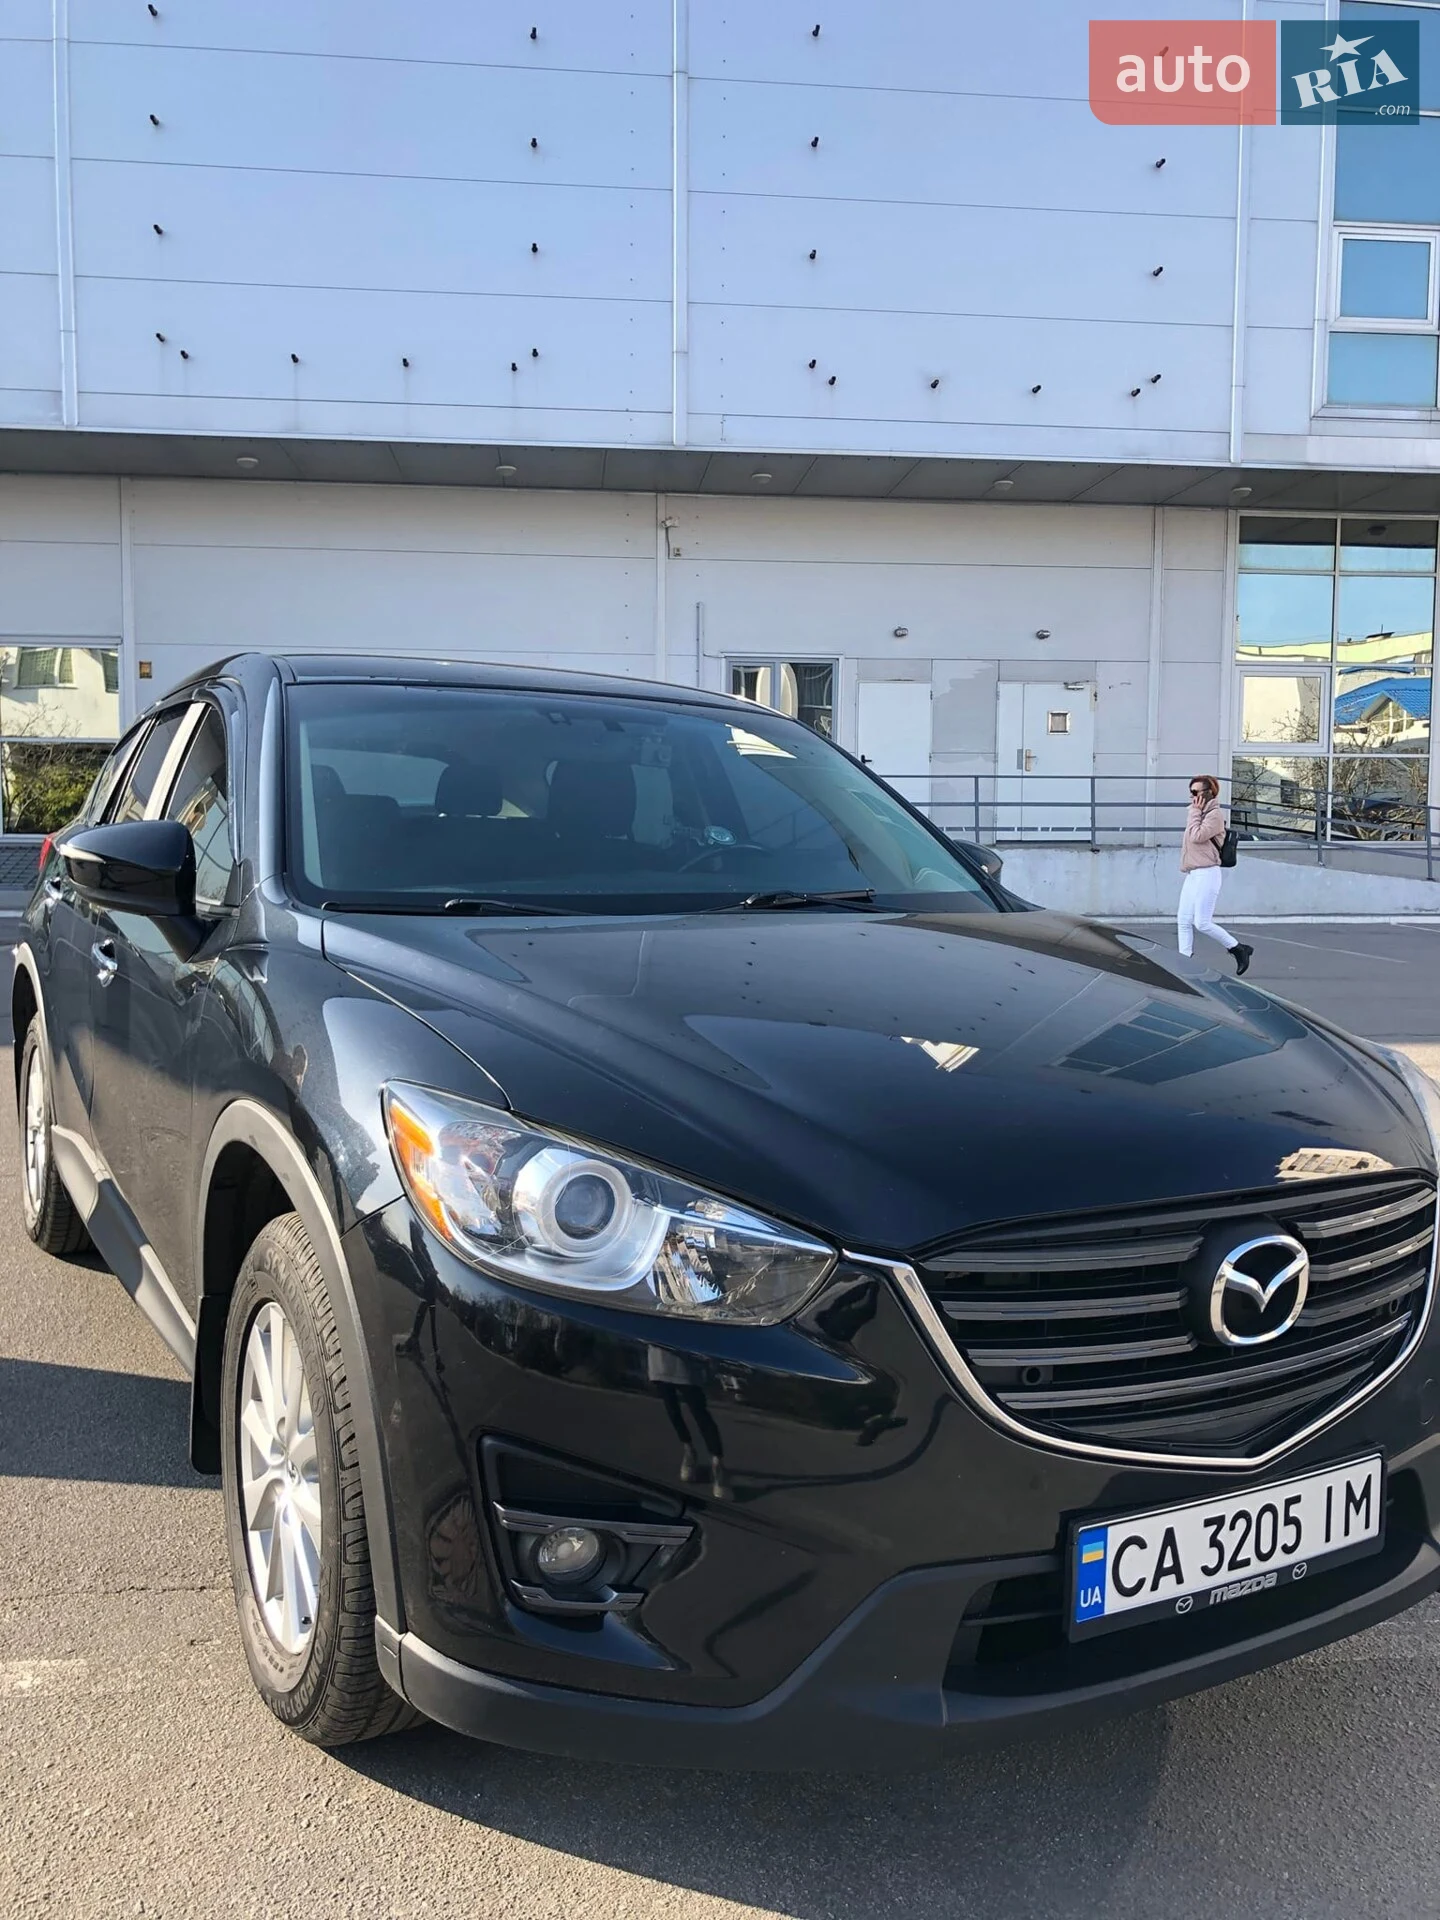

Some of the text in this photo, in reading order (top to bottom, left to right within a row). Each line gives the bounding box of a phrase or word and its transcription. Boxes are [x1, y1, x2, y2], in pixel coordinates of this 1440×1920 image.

[1112, 1474, 1372, 1597] CA 3205 IM
[1081, 1586, 1101, 1607] UA
